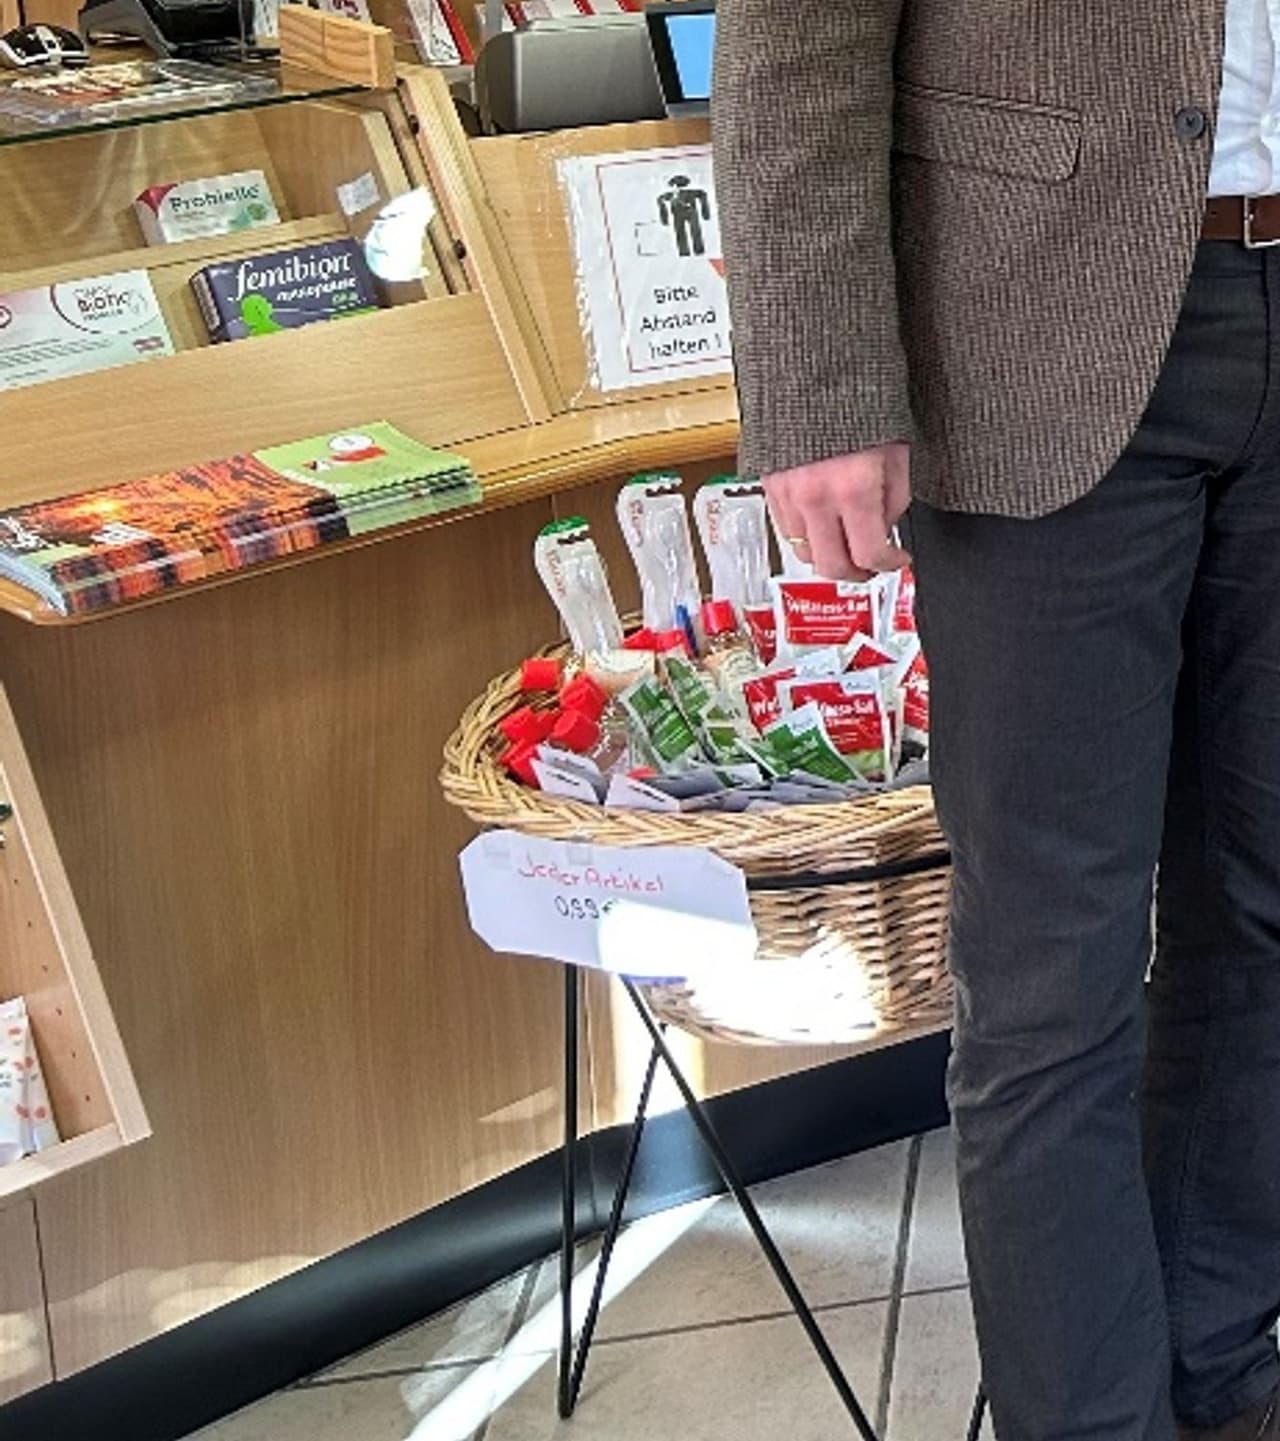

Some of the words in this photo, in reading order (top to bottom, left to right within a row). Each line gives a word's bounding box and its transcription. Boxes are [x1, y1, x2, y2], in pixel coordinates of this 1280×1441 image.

[235, 253, 353, 301] femibion
[653, 286, 700, 304] Bitte
[640, 306, 717, 334] Abstand
[648, 337, 711, 360] halten
[518, 851, 580, 887] Jeder
[585, 866, 664, 892] Artikel
